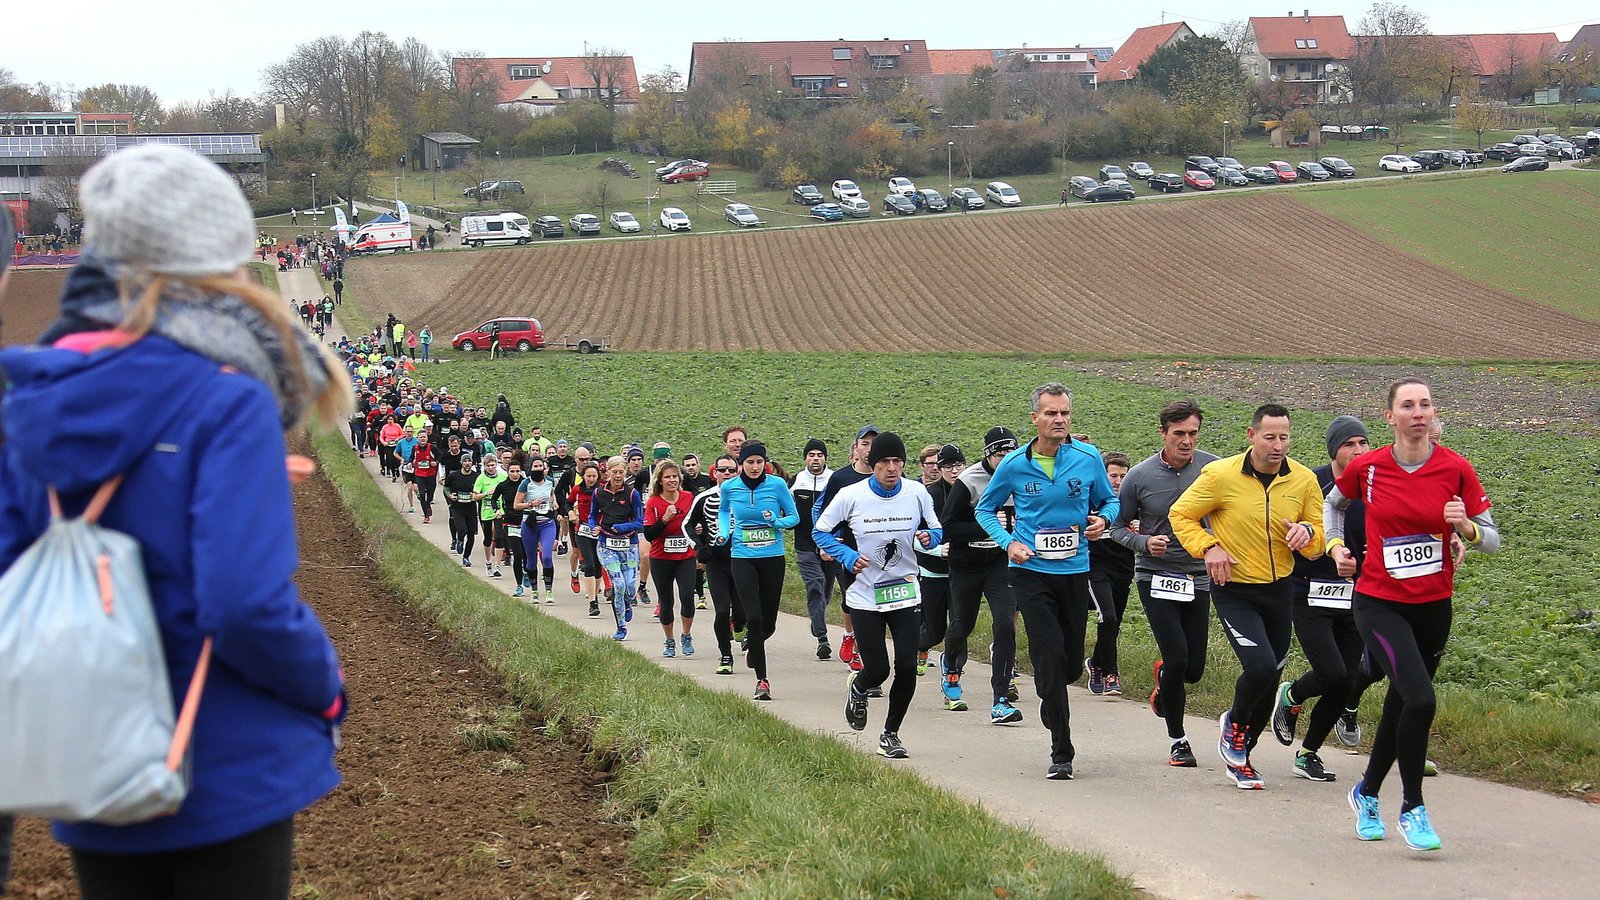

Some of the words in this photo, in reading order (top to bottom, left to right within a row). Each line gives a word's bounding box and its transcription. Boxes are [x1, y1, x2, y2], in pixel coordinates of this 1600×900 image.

[747, 530, 770, 540] 1403
[1042, 535, 1073, 548] 1865
[669, 539, 687, 547] 1858
[1394, 545, 1433, 564] 1880
[1159, 579, 1187, 592] 1861
[1318, 585, 1345, 597] 1871
[881, 586, 909, 600] 1156
